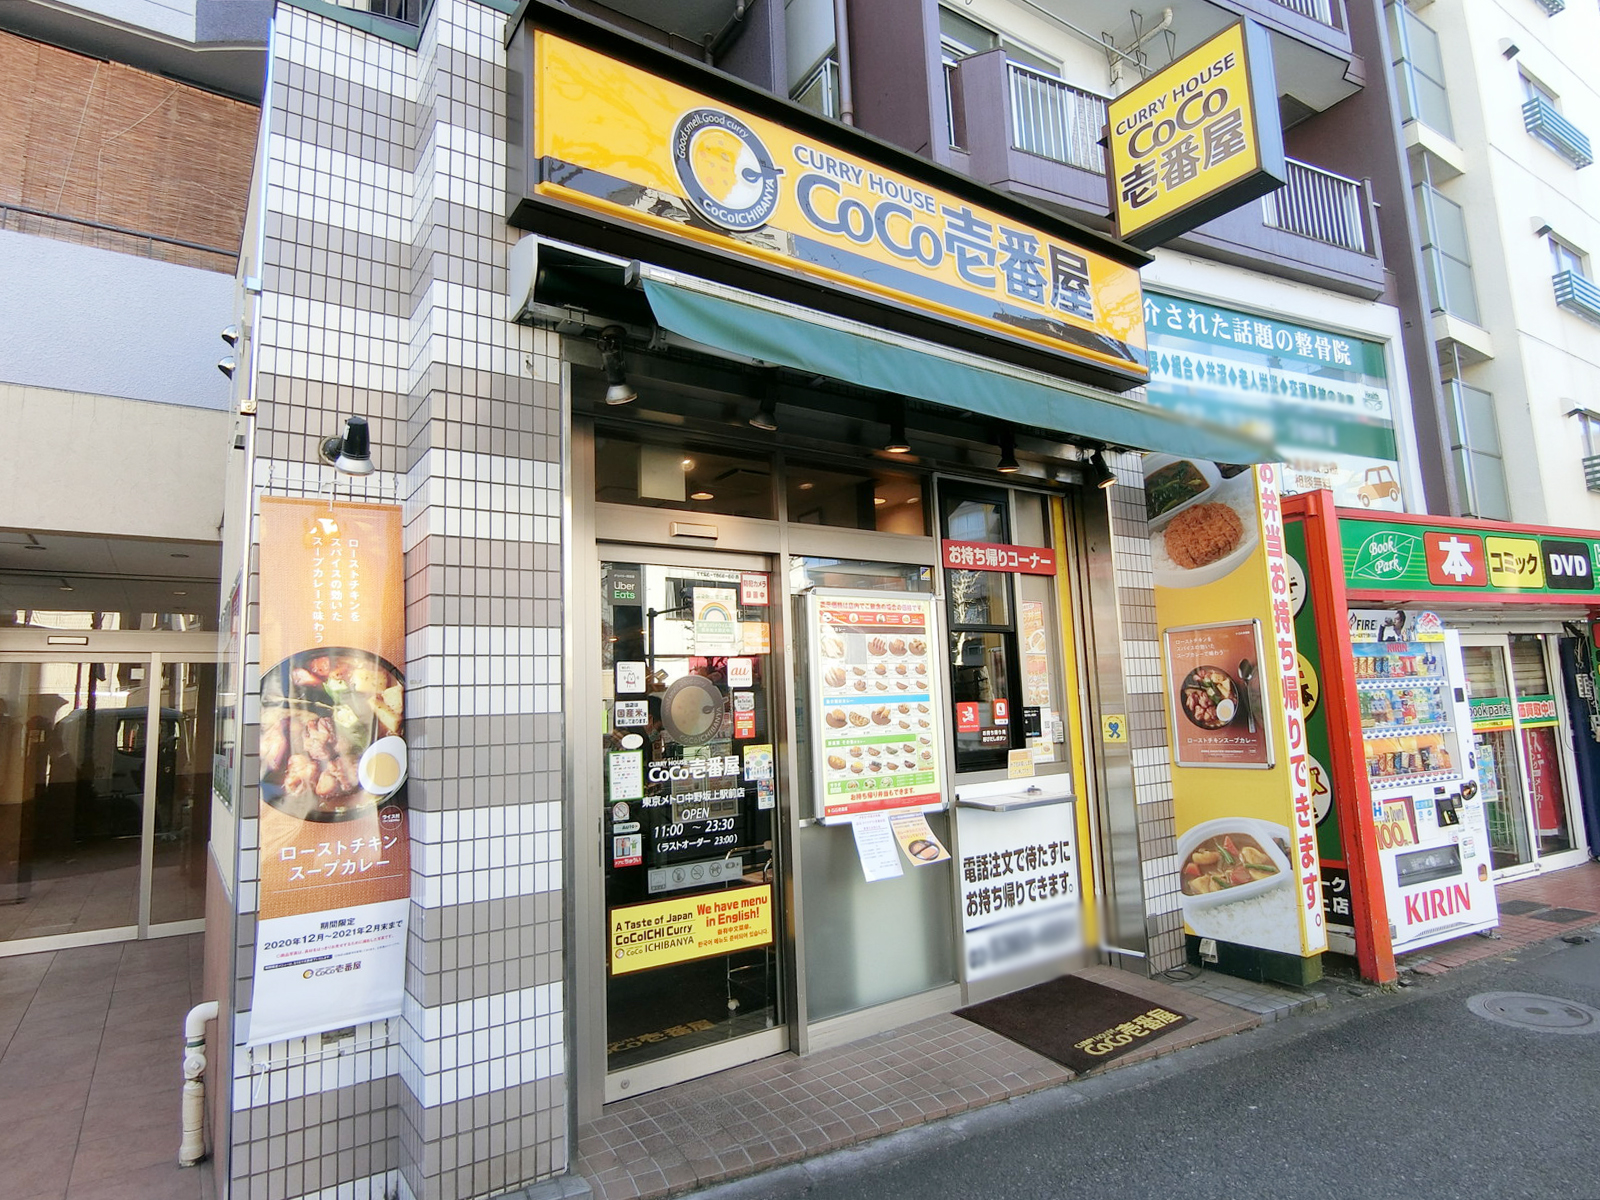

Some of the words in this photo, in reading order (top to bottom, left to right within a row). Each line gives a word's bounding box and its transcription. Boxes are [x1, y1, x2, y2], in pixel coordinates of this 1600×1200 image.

[1116, 94, 1167, 136] CURRY
[1172, 53, 1235, 102] HOUSE
[1128, 88, 1228, 159] CoCo
[677, 130, 686, 159] Good
[702, 113, 725, 125] Good
[726, 120, 749, 138] curry
[1121, 107, 1246, 209] 壱番屋
[794, 145, 864, 185] CURRY
[868, 173, 935, 213] HOUSE
[1369, 536, 1397, 555] Book
[949, 545, 1051, 569] お持ち帰りコーナー
[1375, 554, 1402, 574] Park
[1439, 536, 1473, 582] 本
[1490, 552, 1537, 575] コミック
[1549, 554, 1587, 577] DVD
[312, 537, 325, 643] スープカレーで味わう
[330, 537, 343, 622] スパイスの効いた
[348, 539, 361, 622] ローストチキンを
[614, 581, 635, 590] Uber
[614, 590, 636, 599] Eats
[1356, 619, 1377, 631] FIRE
[1387, 643, 1407, 653] KIRIN
[730, 666, 749, 676] au
[642, 788, 746, 808] 東京メトロ中野坂上駅前店
[682, 807, 710, 820] OPEN
[655, 823, 683, 838] 11:00
[705, 818, 734, 833] 23:30
[280, 836, 398, 861] ローストチキン
[289, 859, 390, 881] スープカレー
[963, 840, 1071, 883] 電話注文で待たずに
[966, 871, 1074, 917] お持ち帰りできます。
[1405, 882, 1471, 925] KIRIN
[697, 904, 711, 916] We
[714, 900, 740, 913] have
[741, 895, 768, 908] menu
[320, 917, 356, 930] 期間限定
[615, 922, 622, 932] A
[625, 918, 651, 930] Taste
[654, 915, 664, 925] of
[666, 912, 693, 923] Japan
[706, 916, 716, 927] in
[718, 907, 760, 925] English!
[667, 924, 693, 936] Curry
[645, 936, 695, 953] ICHIBANYA
